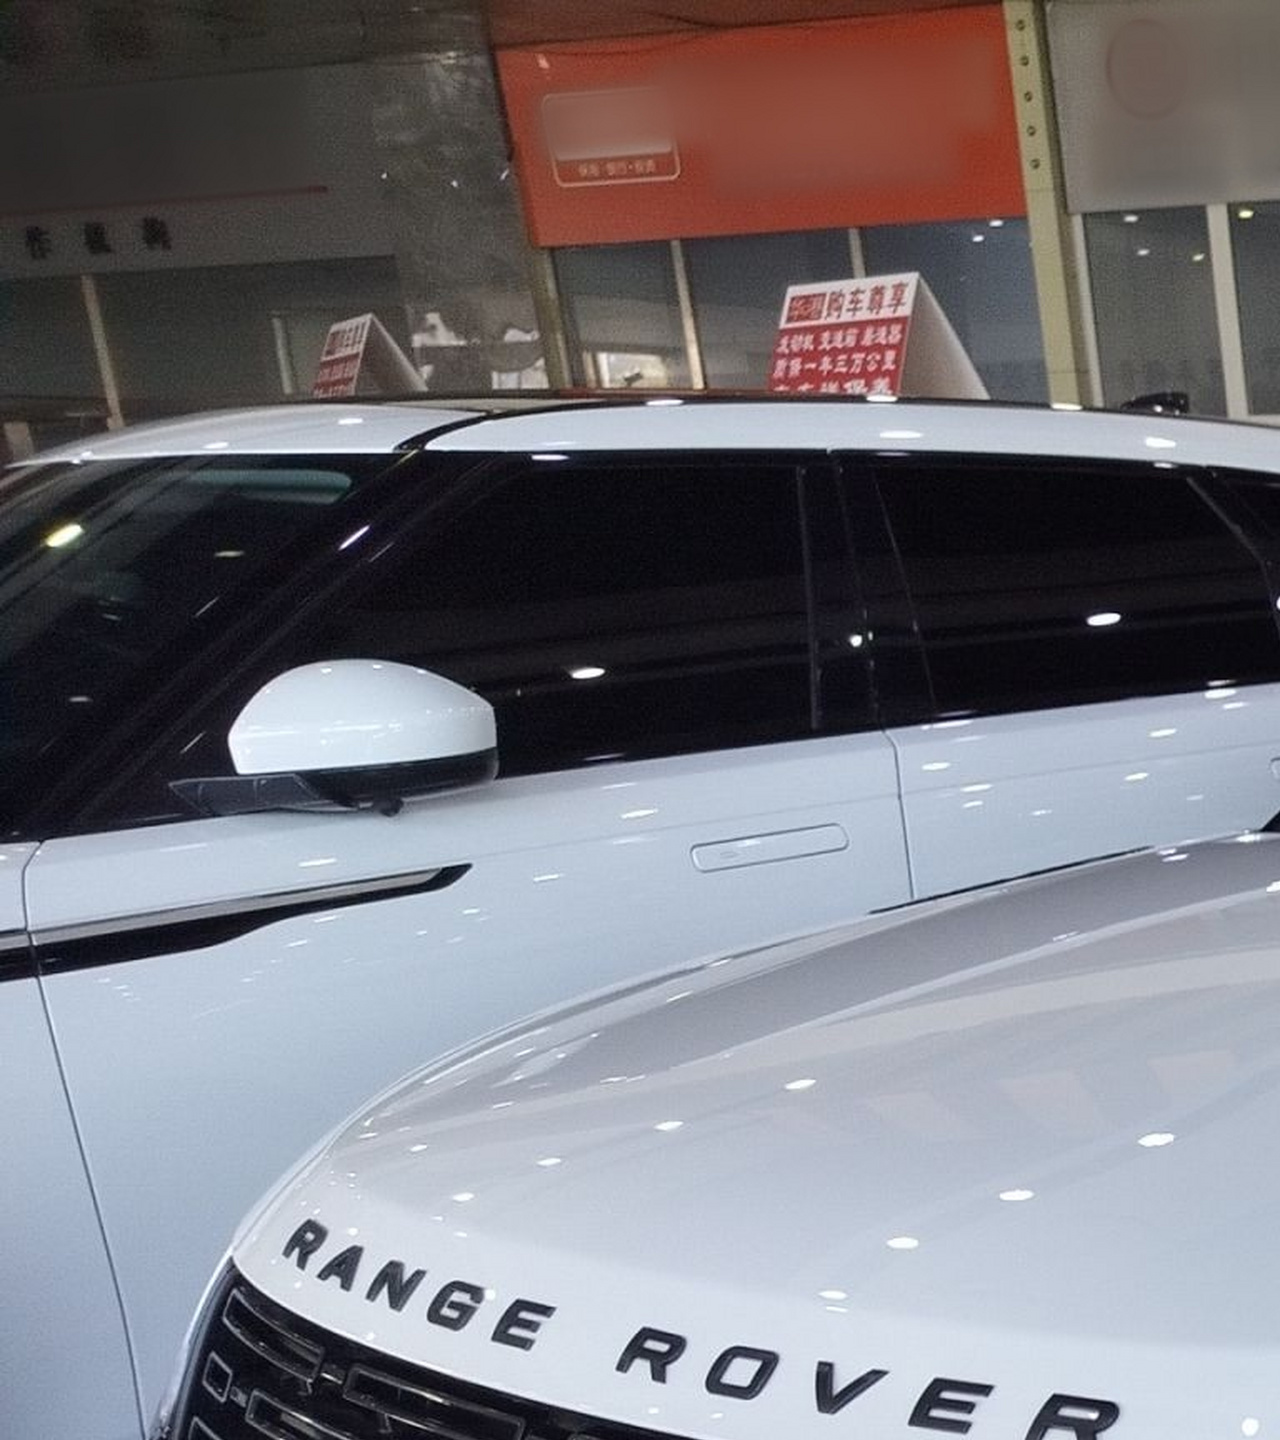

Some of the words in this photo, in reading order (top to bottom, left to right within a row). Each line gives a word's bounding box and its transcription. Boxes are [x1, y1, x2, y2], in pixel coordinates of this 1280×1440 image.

[826, 282, 908, 318] 购车尊享
[283, 1217, 556, 1352] RANGE
